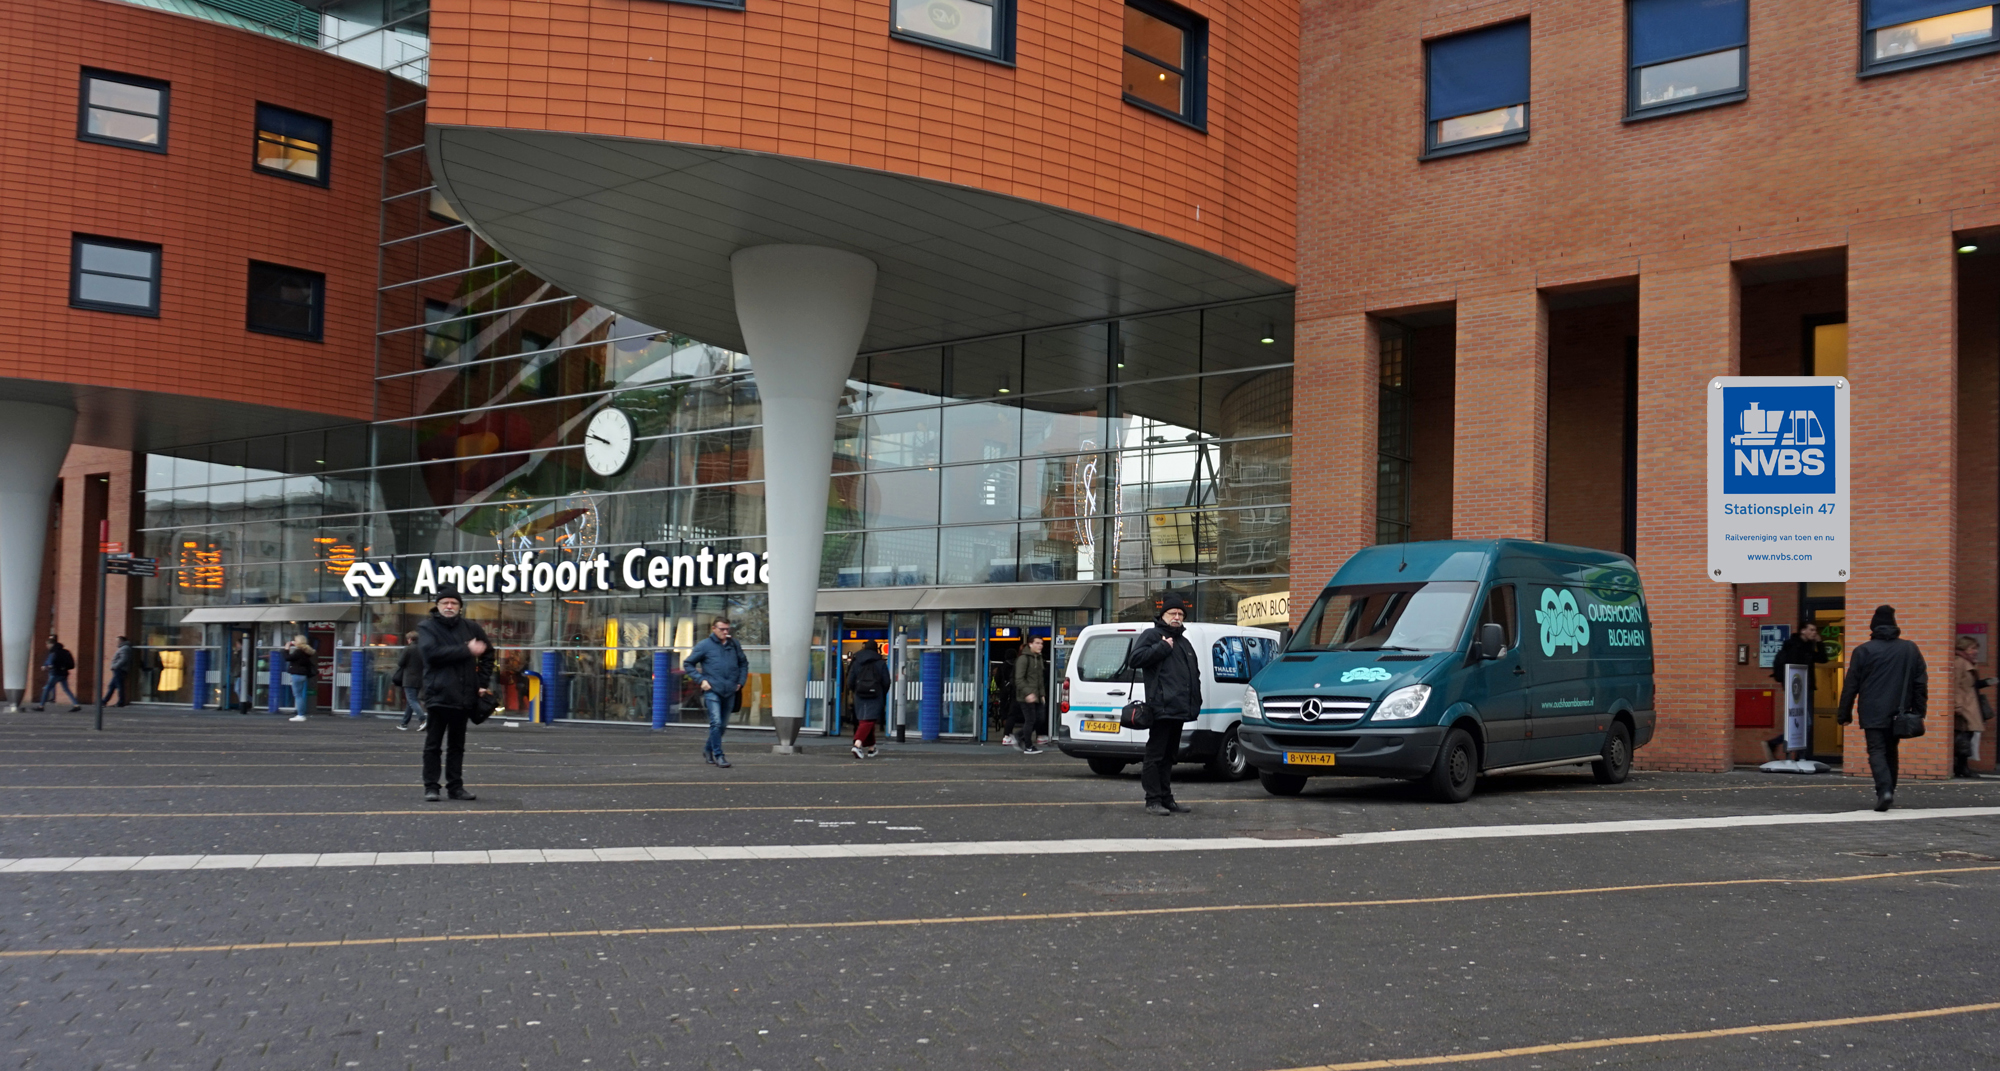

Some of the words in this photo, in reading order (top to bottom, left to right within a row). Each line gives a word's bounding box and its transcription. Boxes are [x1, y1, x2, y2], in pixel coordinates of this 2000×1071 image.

[1734, 448, 1826, 476] NVBS
[1724, 503, 1814, 517] Stationsplein
[1817, 503, 1836, 515] 47
[1725, 534, 1778, 542] Railvereniging
[1747, 553, 1813, 561] www.nvbs.com
[413, 551, 610, 595] Amersfoort
[1752, 602, 1759, 611] B
[1588, 603, 1643, 623] OUDSHOORN
[1608, 629, 1645, 646] BLOEMEN
[1820, 626, 1840, 638] 49
[1086, 722, 1117, 731] V-544-JB
[1290, 753, 1331, 763] 8-VXH-47
